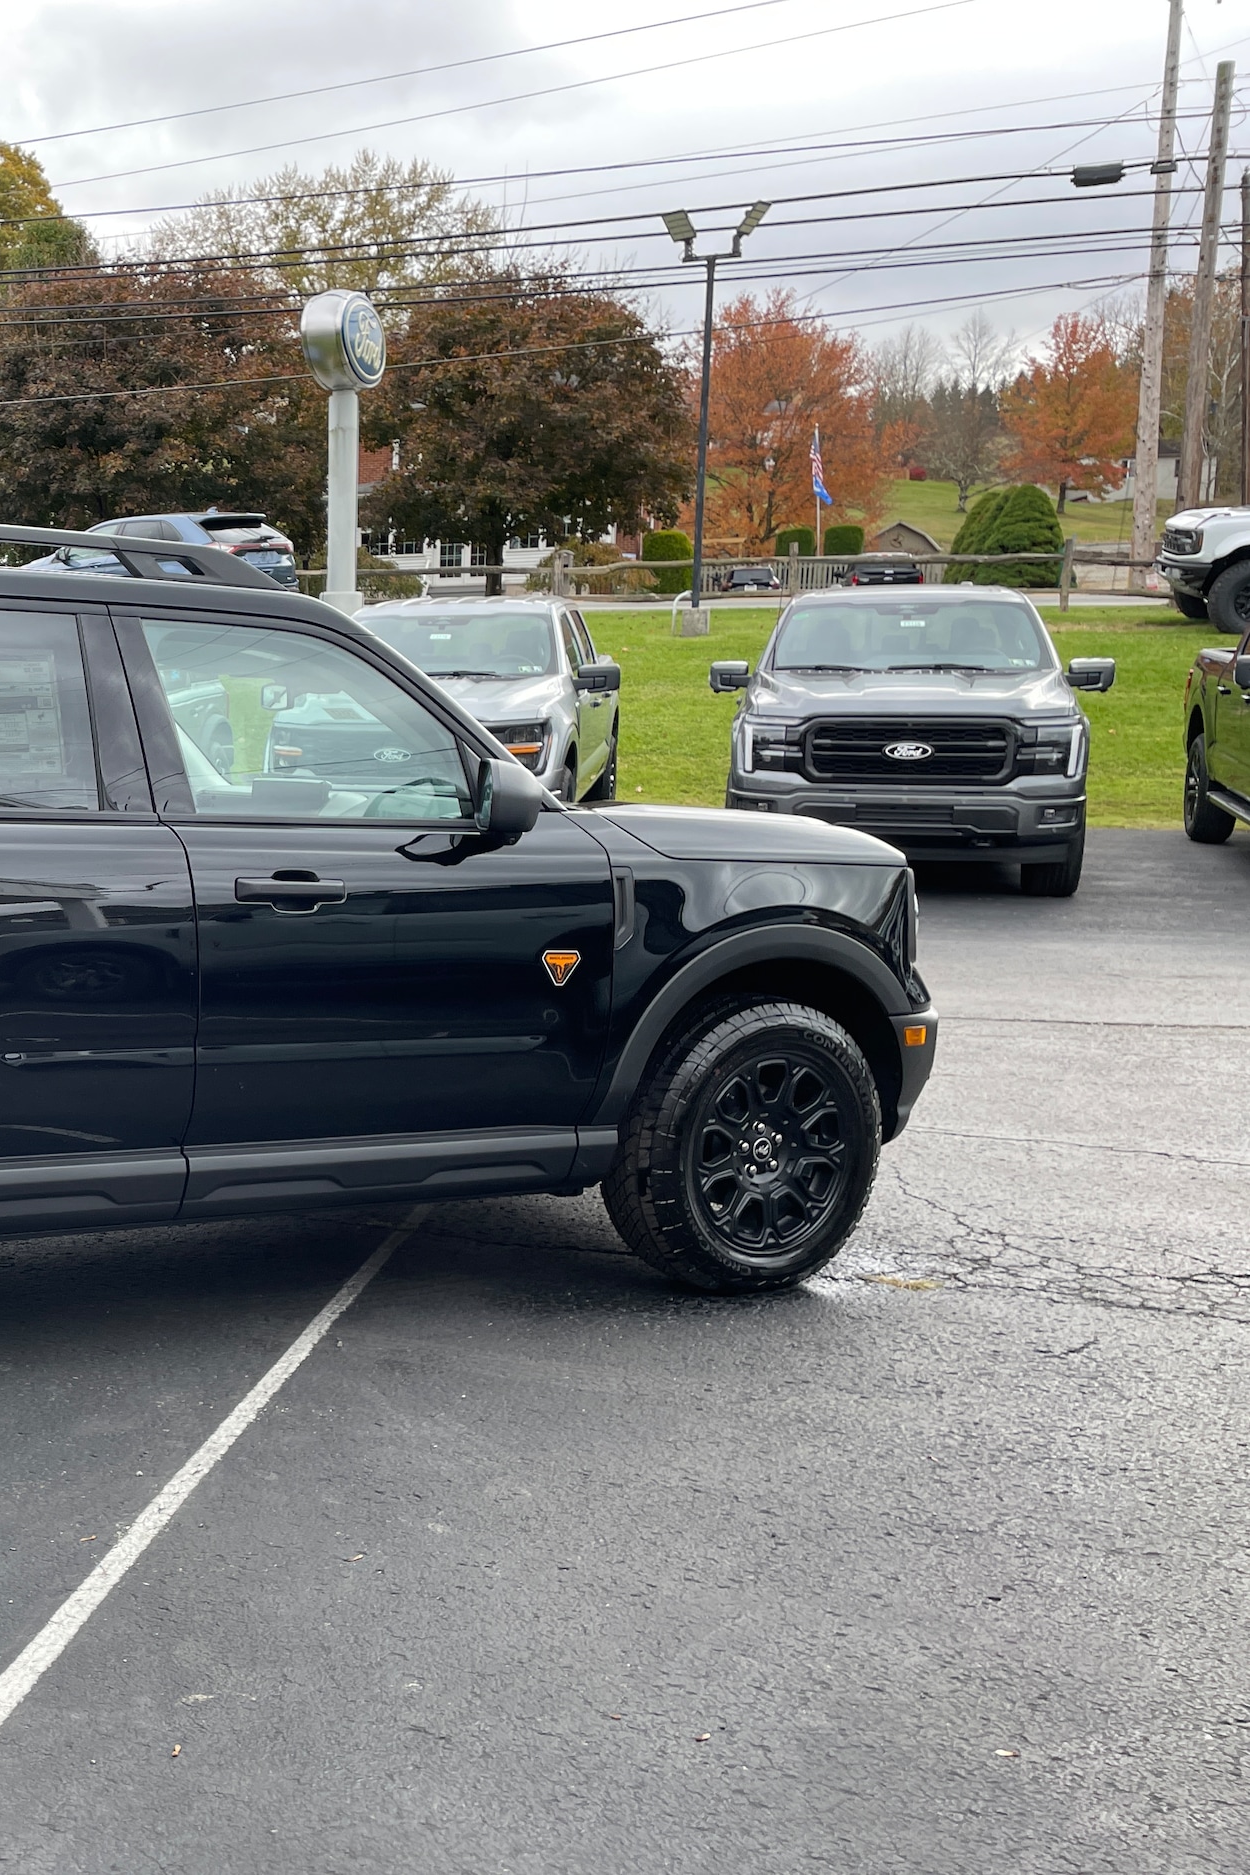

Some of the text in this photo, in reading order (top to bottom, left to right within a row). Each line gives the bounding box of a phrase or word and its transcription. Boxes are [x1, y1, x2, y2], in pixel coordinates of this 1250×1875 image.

[354, 311, 381, 370] Ford
[380, 749, 404, 761] Ford
[893, 744, 924, 758] Ford
